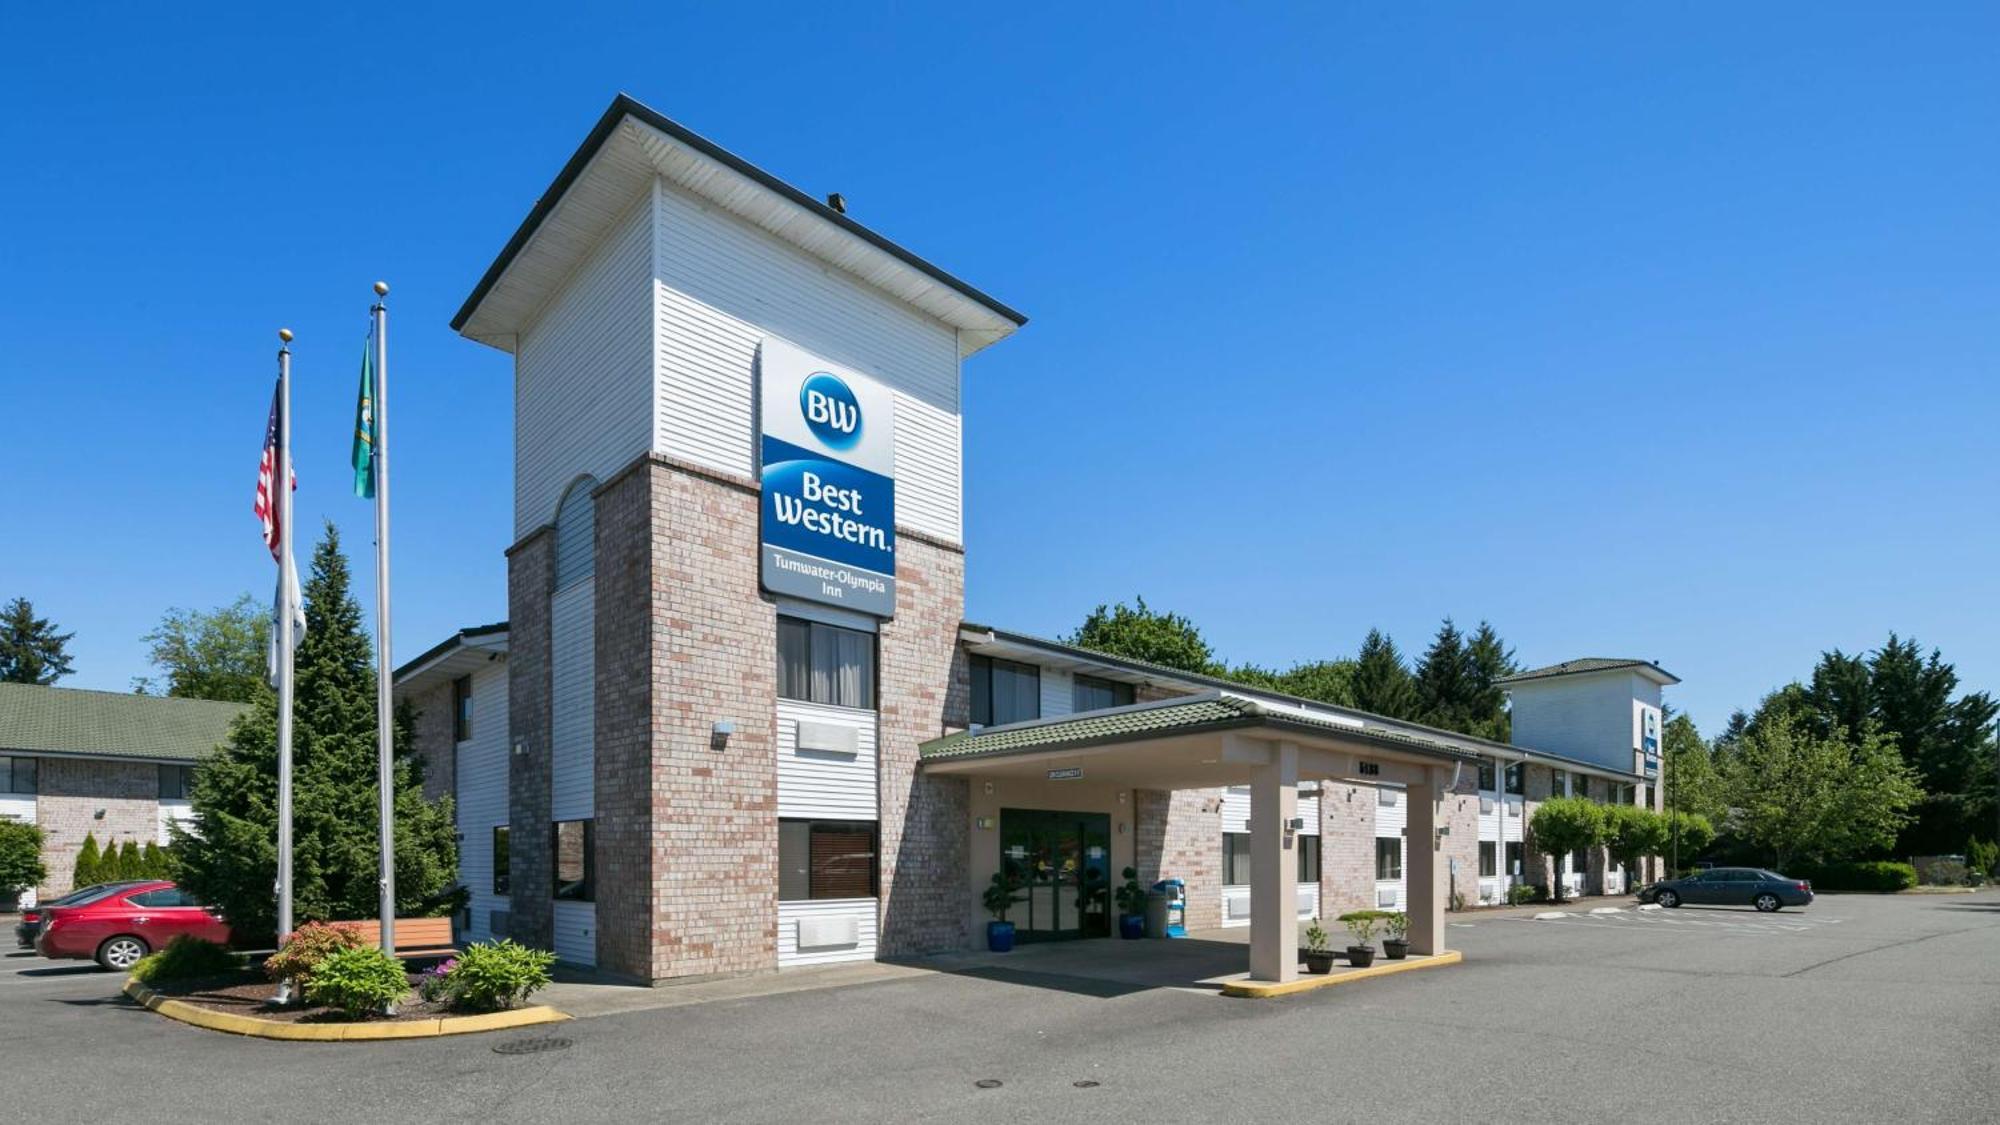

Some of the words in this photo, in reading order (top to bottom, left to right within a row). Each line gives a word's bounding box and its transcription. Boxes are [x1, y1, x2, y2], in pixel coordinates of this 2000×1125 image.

[807, 389, 856, 433] BW
[803, 471, 863, 515] Best
[773, 553, 885, 593] Tumwater-Olympia
[822, 582, 843, 598] Inn
